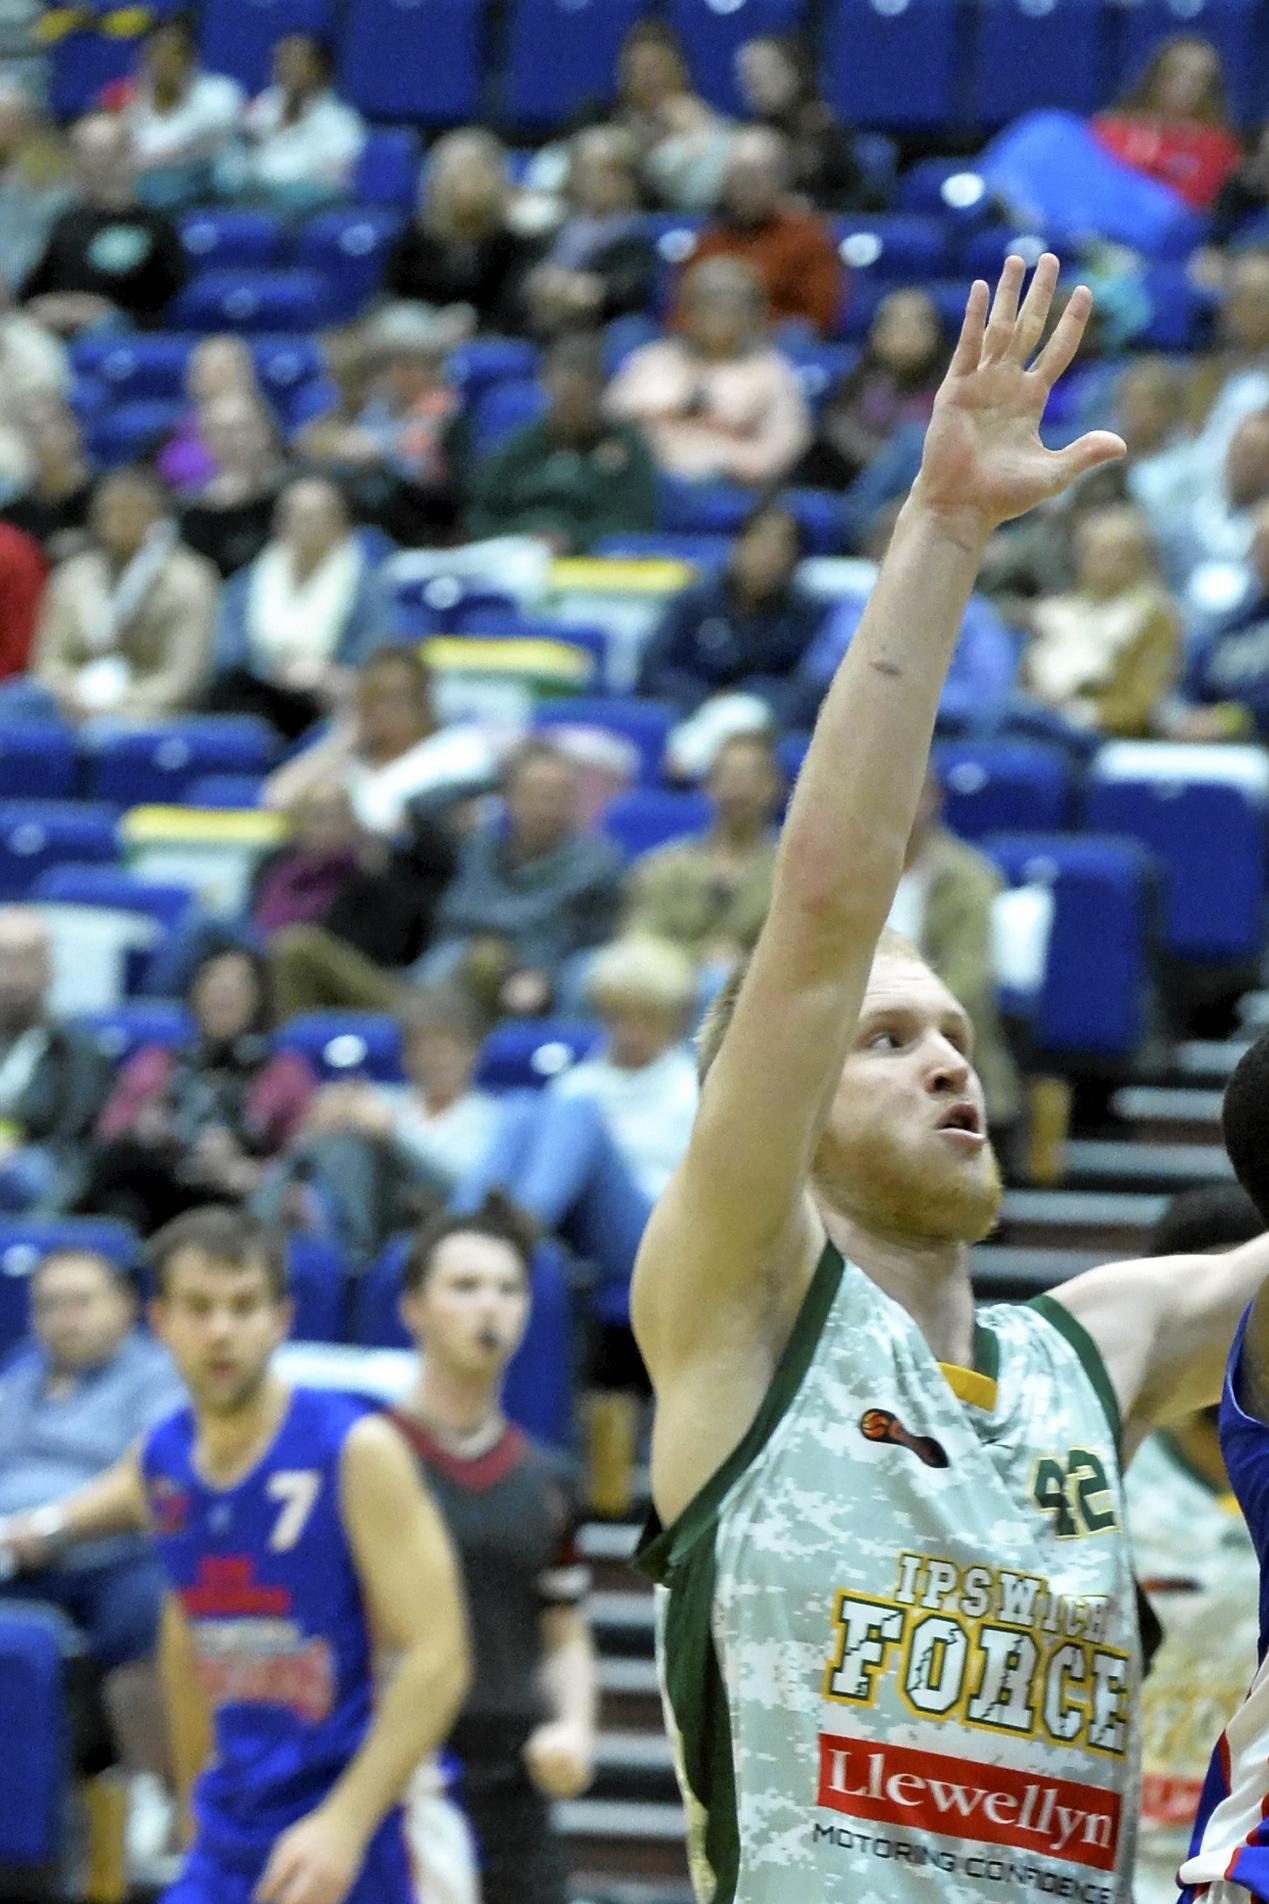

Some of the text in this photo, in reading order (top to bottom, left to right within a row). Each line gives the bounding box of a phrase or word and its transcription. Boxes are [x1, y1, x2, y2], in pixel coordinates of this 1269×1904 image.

[266, 1467, 321, 1555] 7
[1027, 1445, 1118, 1538] 42
[828, 1592, 1130, 1757] FORCE
[829, 1748, 1113, 1850] Llewellyn
[813, 1822, 955, 1872] MOTORING
